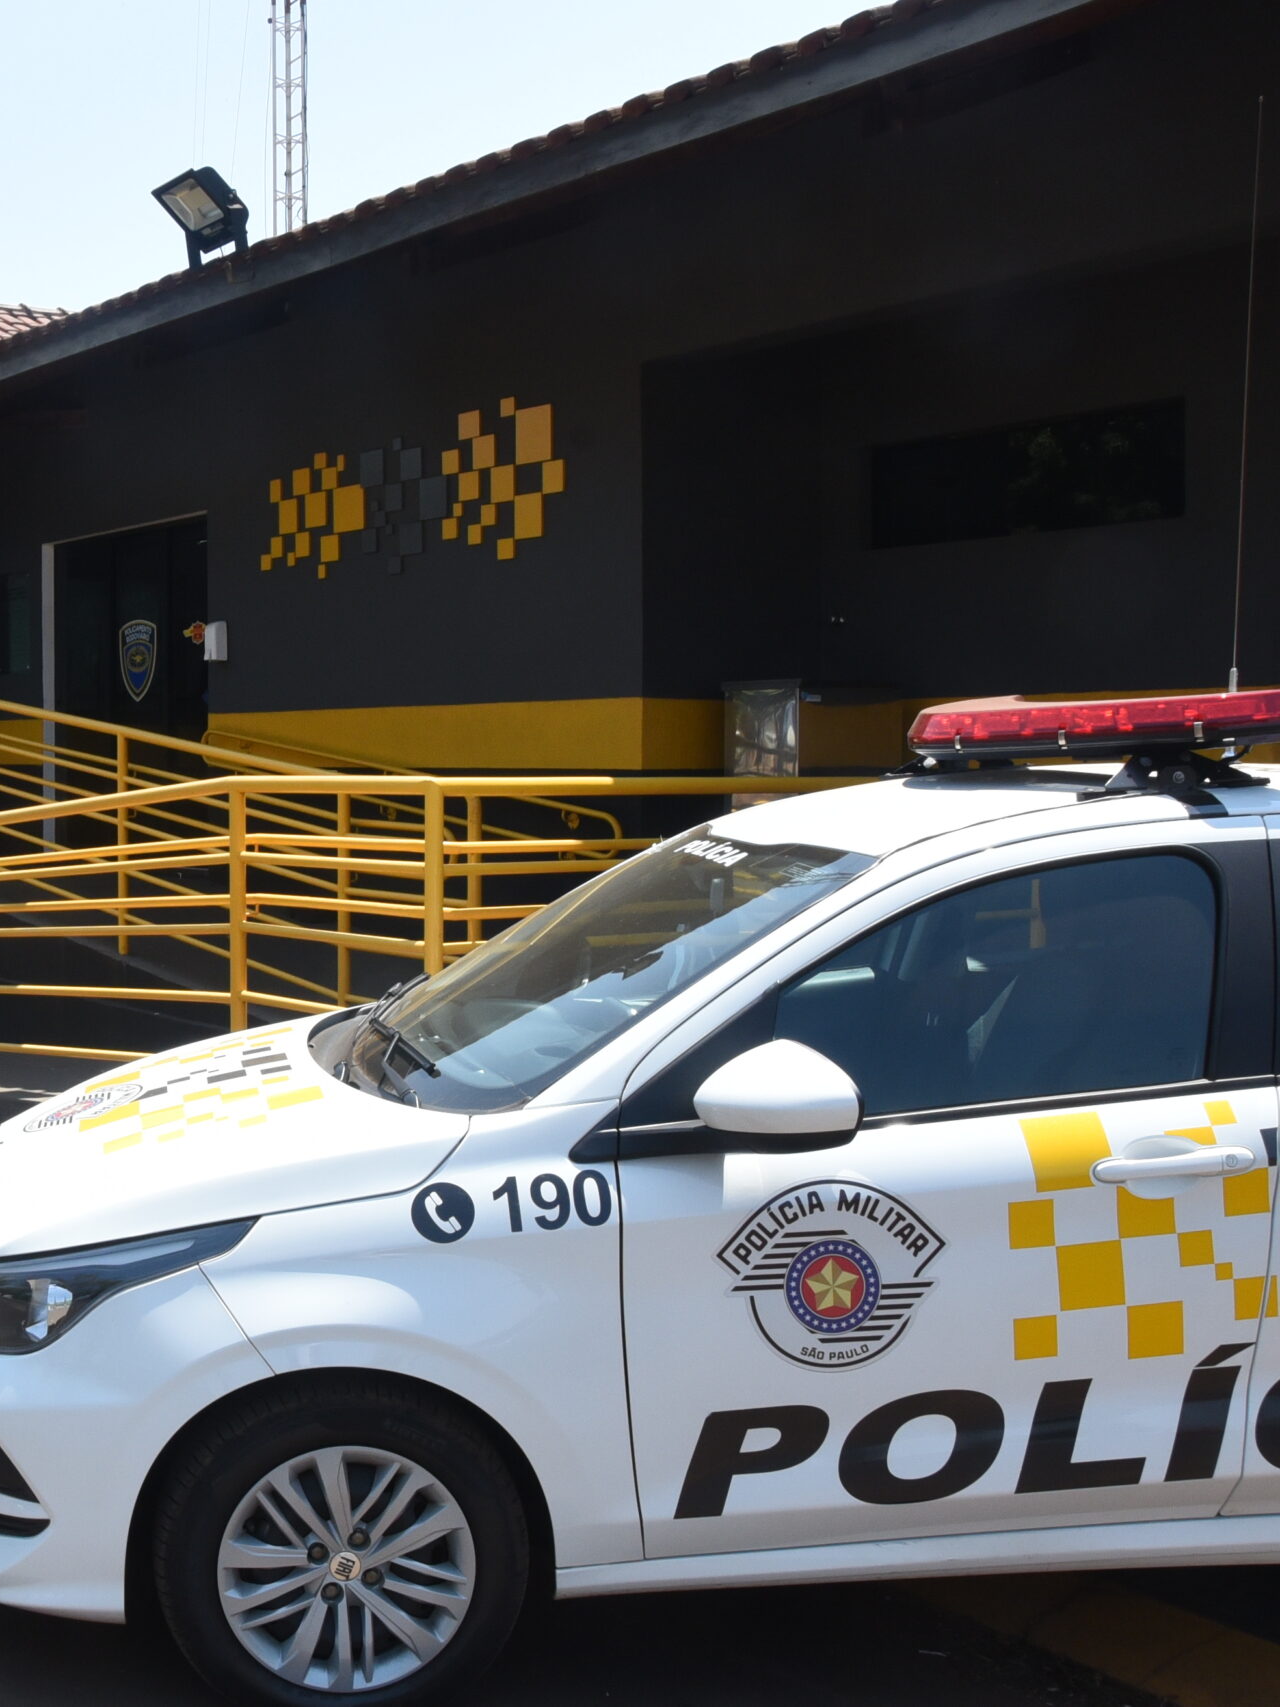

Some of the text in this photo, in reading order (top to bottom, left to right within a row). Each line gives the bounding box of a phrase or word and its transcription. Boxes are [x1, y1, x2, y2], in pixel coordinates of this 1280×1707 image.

[673, 839, 749, 867] POLÍCIA
[492, 1169, 612, 1233] 190
[732, 1189, 929, 1265] POLÍCIA MILITAR
[800, 1344, 869, 1361] SÃO PAULO
[673, 1342, 1280, 1519] POLÍ
[334, 1556, 356, 1581] FIAT
